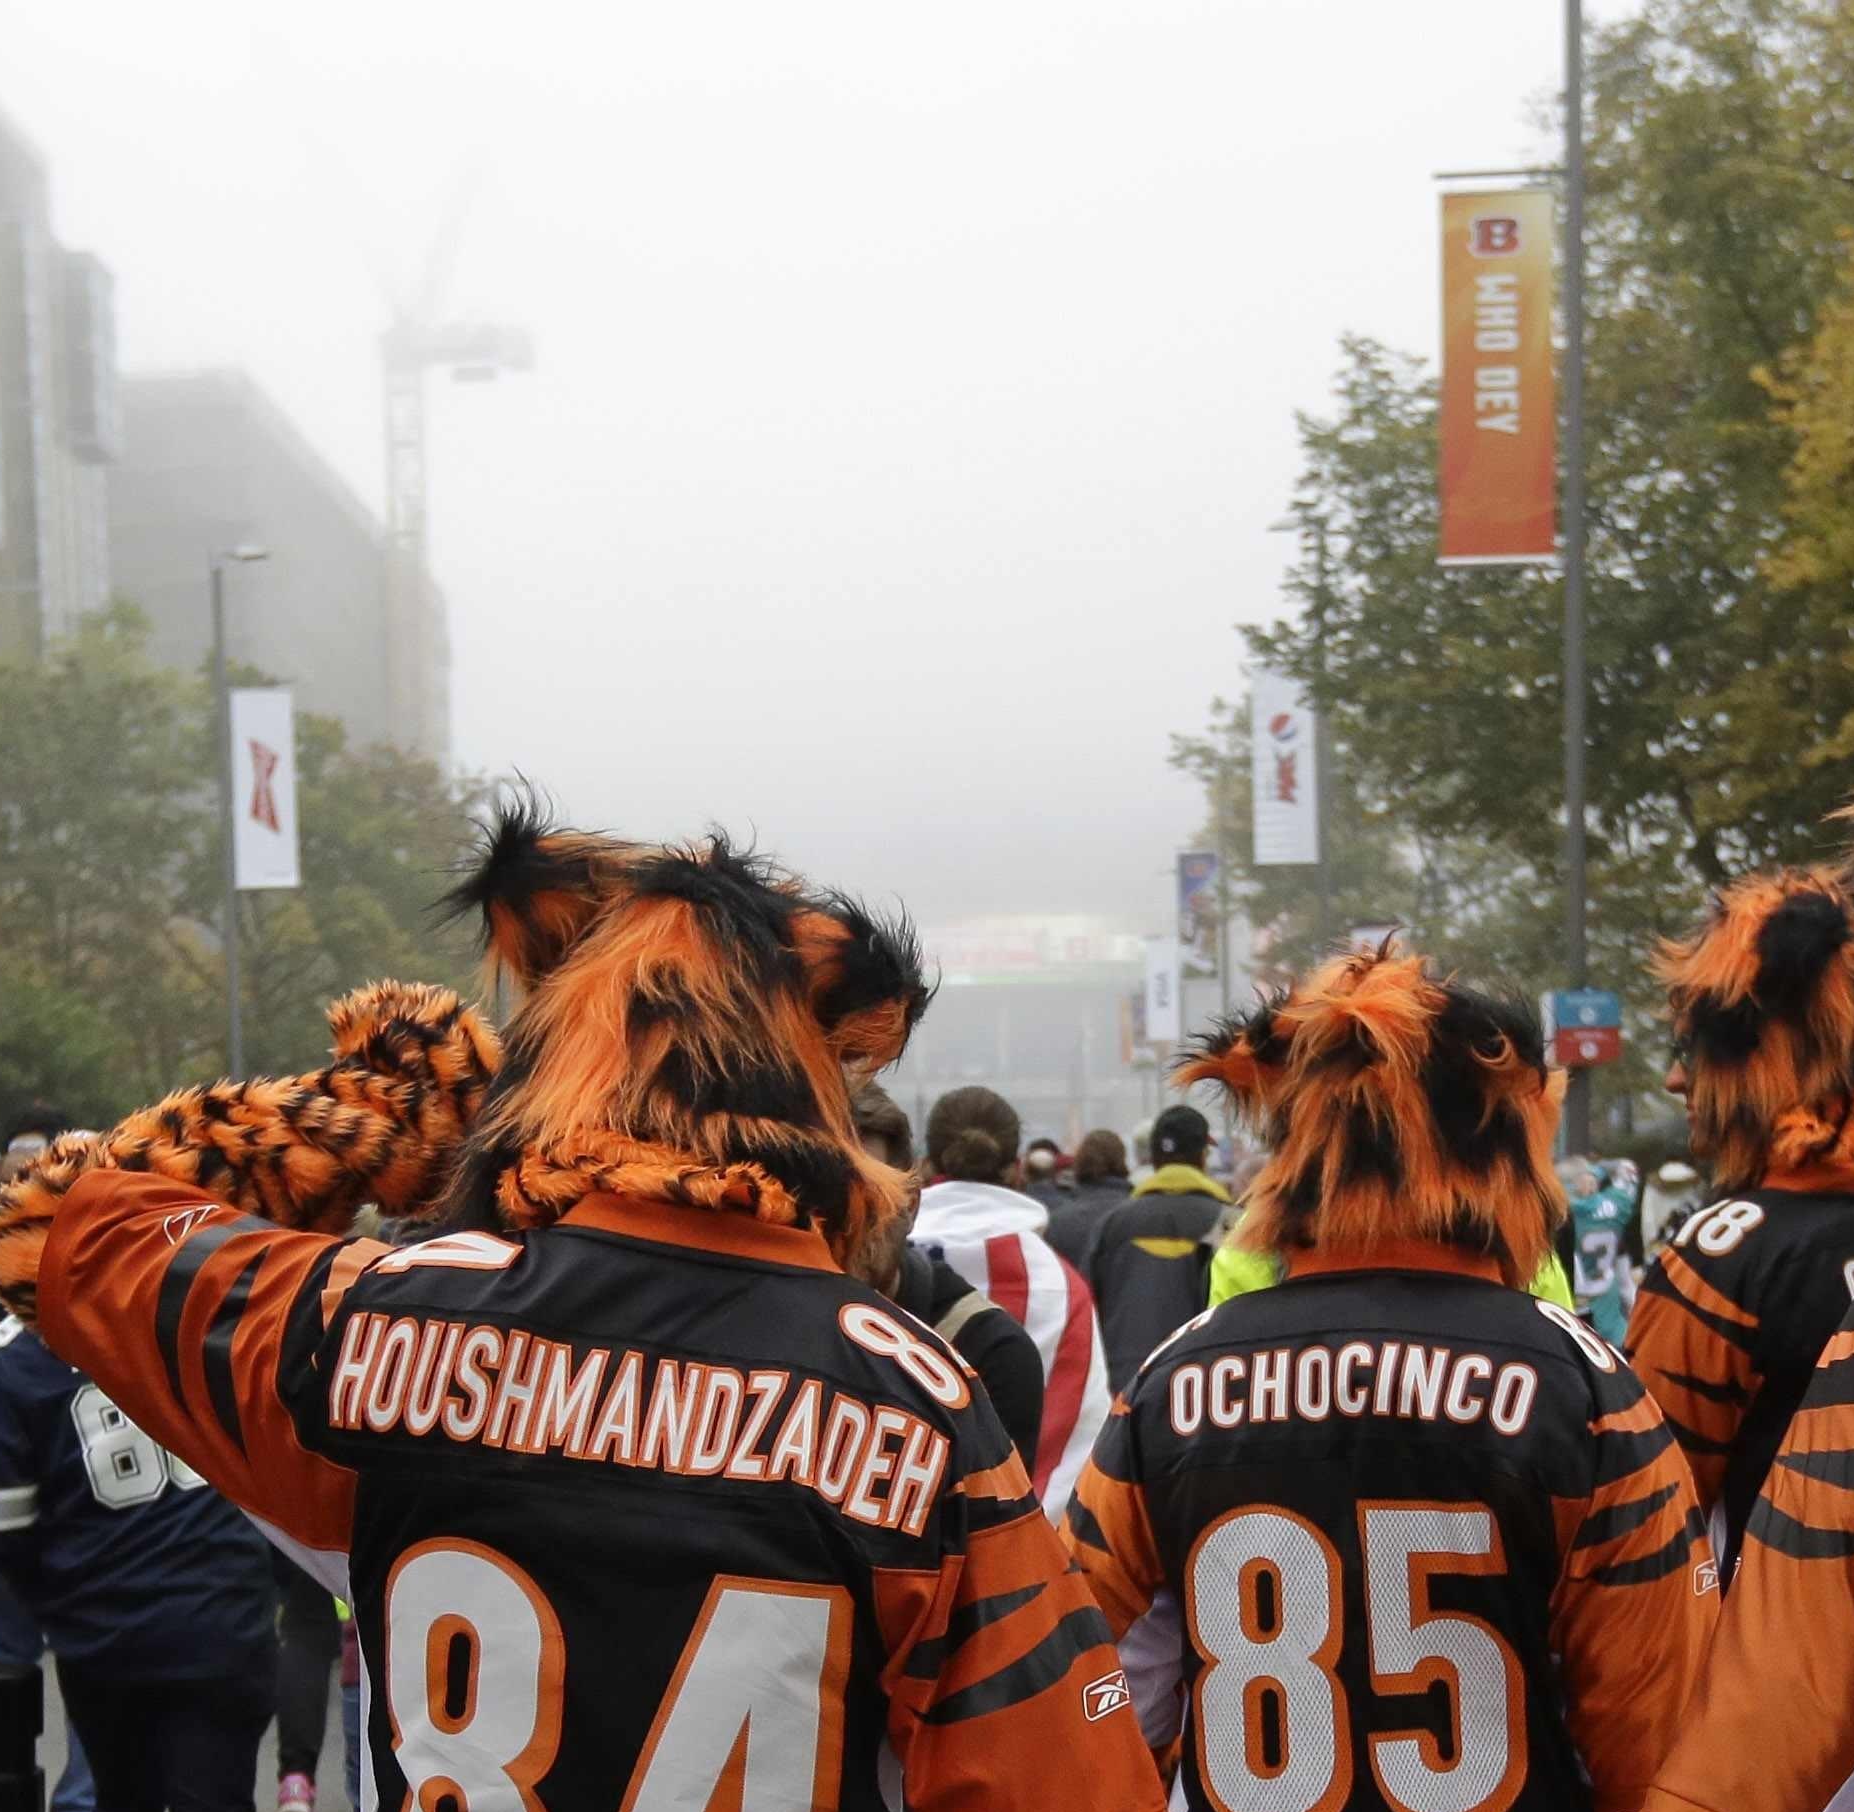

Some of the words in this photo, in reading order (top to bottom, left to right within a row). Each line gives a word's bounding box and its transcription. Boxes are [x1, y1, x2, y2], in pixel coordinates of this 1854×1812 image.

[1474, 272, 1520, 352] WHO
[1474, 364, 1520, 434] DEY
[839, 1301, 978, 1409] 8
[1169, 1342, 1538, 1436] OCHOCINCO
[70, 1383, 209, 1510] 8
[329, 1311, 951, 1538] HOUSHMANDZADEH
